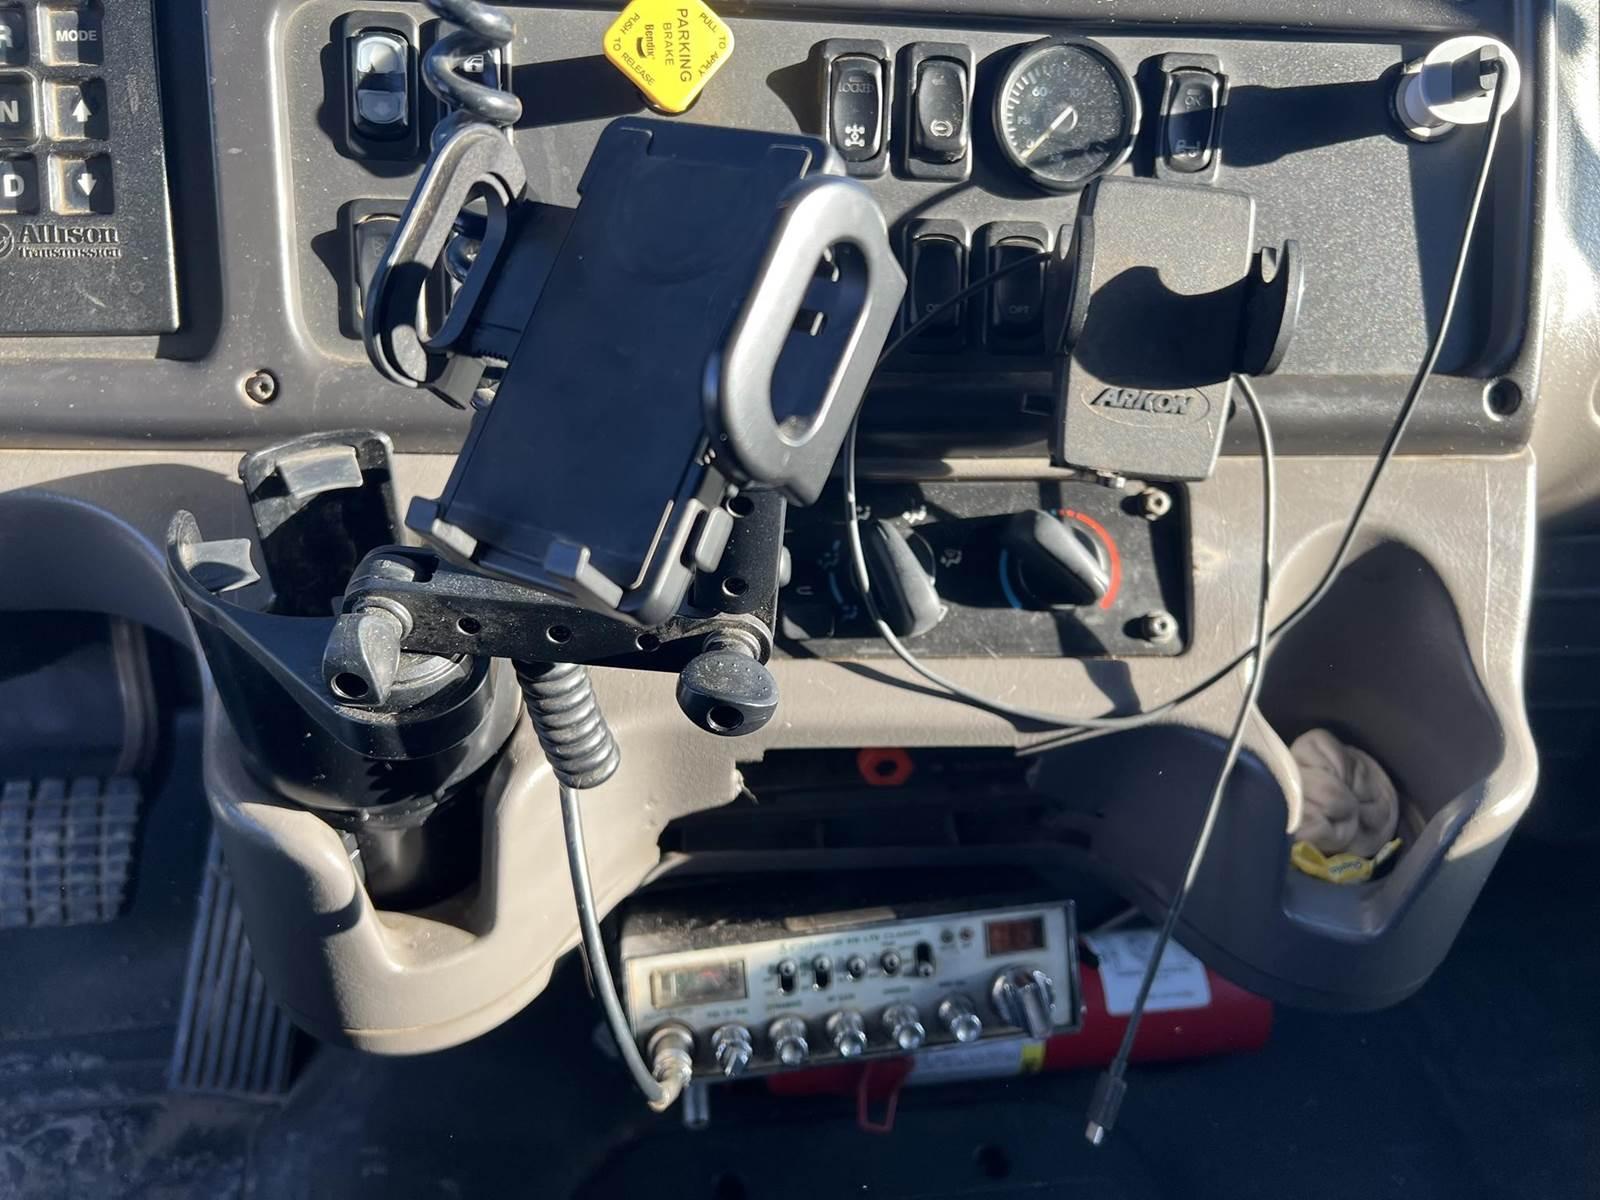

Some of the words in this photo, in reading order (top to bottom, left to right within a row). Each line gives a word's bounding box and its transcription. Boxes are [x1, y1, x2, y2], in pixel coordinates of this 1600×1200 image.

[620, 13, 641, 35] PUSH
[699, 12, 718, 33] PULL
[56, 29, 97, 42] MODE
[613, 37, 622, 52] TO
[644, 24, 656, 57] Bendix
[662, 22, 675, 66] BRAKE
[677, 8, 693, 82] PARKING
[718, 36, 727, 50] TO
[621, 52, 656, 86] RELEASE
[698, 51, 720, 77] APPLY
[1032, 86, 1048, 97] 60
[0, 101, 19, 123] N
[3, 173, 25, 198] D
[18, 223, 120, 243] Allison
[18, 246, 121, 258] Transmission
[1090, 387, 1194, 415] ARKON
